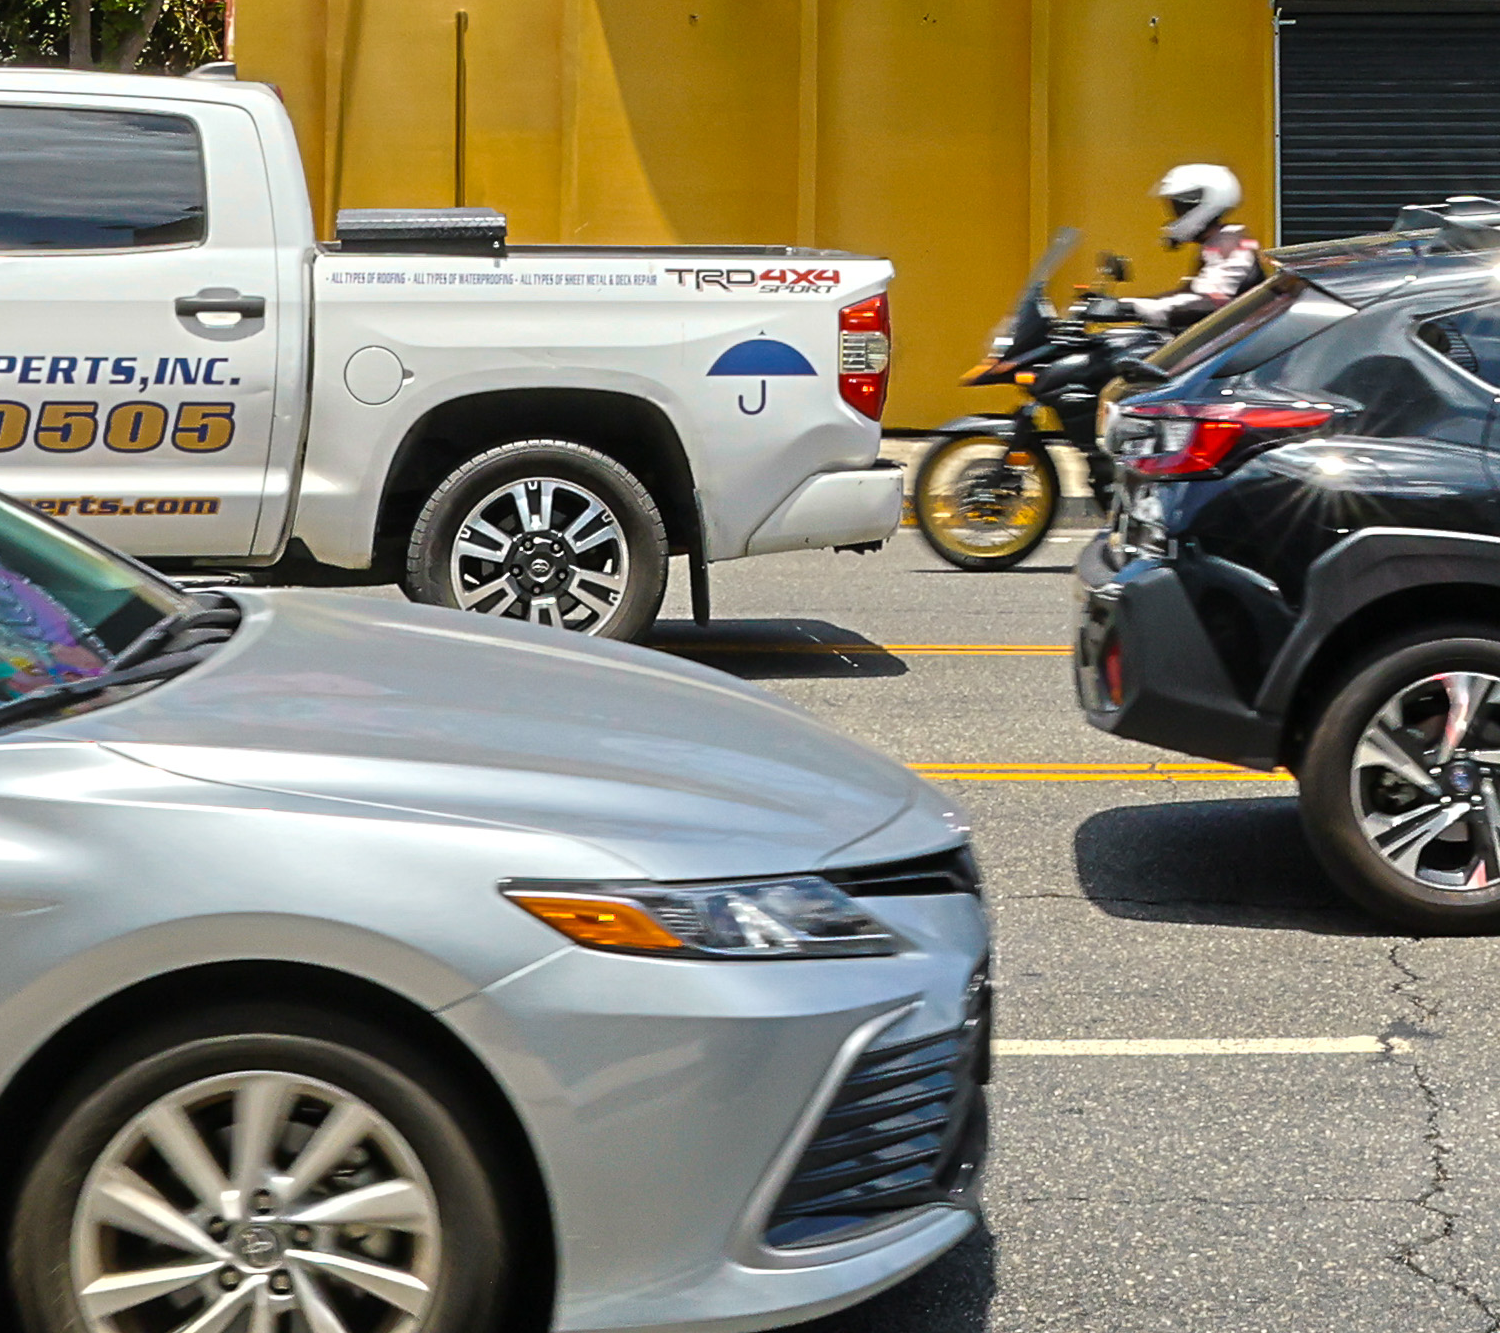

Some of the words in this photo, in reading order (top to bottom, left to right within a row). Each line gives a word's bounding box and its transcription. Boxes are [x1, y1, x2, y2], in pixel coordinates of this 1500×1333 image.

[331, 272, 344, 284] ALL
[345, 272, 366, 284] TYPES
[367, 272, 376, 284] OF
[376, 272, 406, 284] ROOFING
[413, 272, 425, 284] ALL
[427, 272, 447, 284] TYPES
[448, 272, 457, 284] OF
[458, 273, 514, 285] WATERPROOFING
[521, 273, 532, 285] ALL
[533, 273, 554, 285] TYPES
[555, 274, 564, 285] OF
[564, 274, 585, 285] SHEET
[586, 274, 607, 286] METAL
[615, 274, 632, 286] DECK
[633, 274, 658, 286] REPAIR
[664, 268, 758, 293] TRD
[759, 284, 839, 294] SPORT
[23, 495, 223, 517] erts.com
